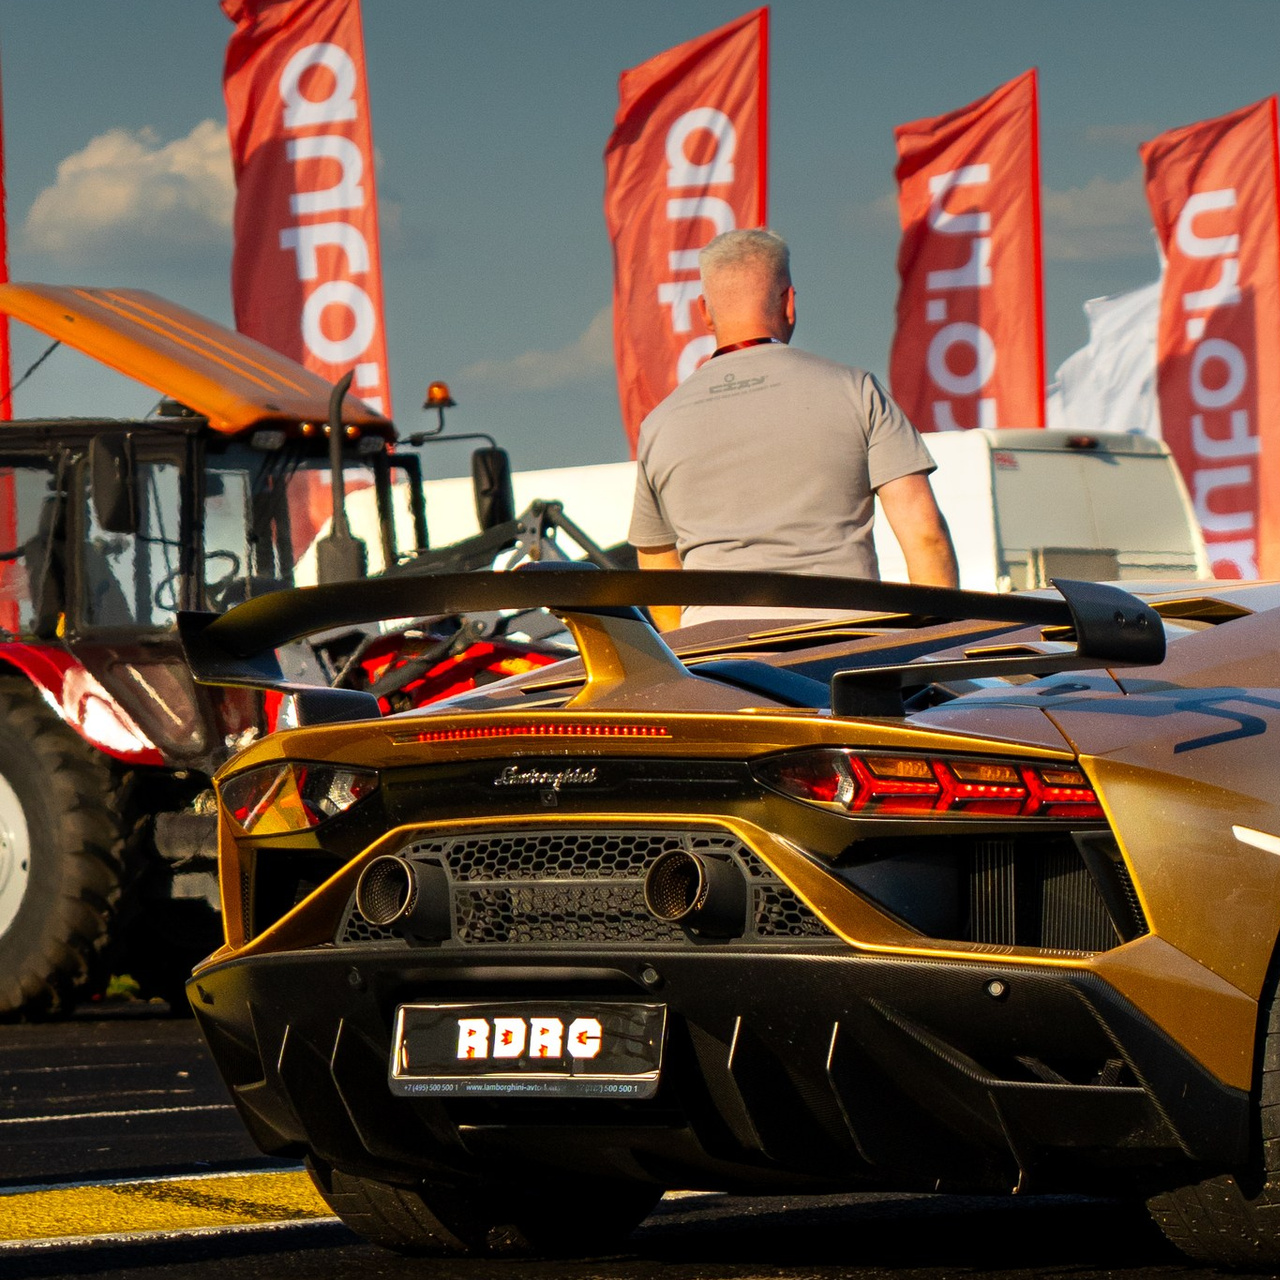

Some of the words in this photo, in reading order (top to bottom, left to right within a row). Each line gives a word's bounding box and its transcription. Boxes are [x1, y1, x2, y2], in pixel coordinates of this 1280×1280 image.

[494, 765, 598, 791] Lamborghini
[456, 1016, 603, 1060] RDRC
[412, 1082, 429, 1093] (495)
[429, 1083, 441, 1092] 500
[442, 1083, 454, 1092] 500
[604, 1084, 618, 1093] 500
[618, 1084, 632, 1093] 500
